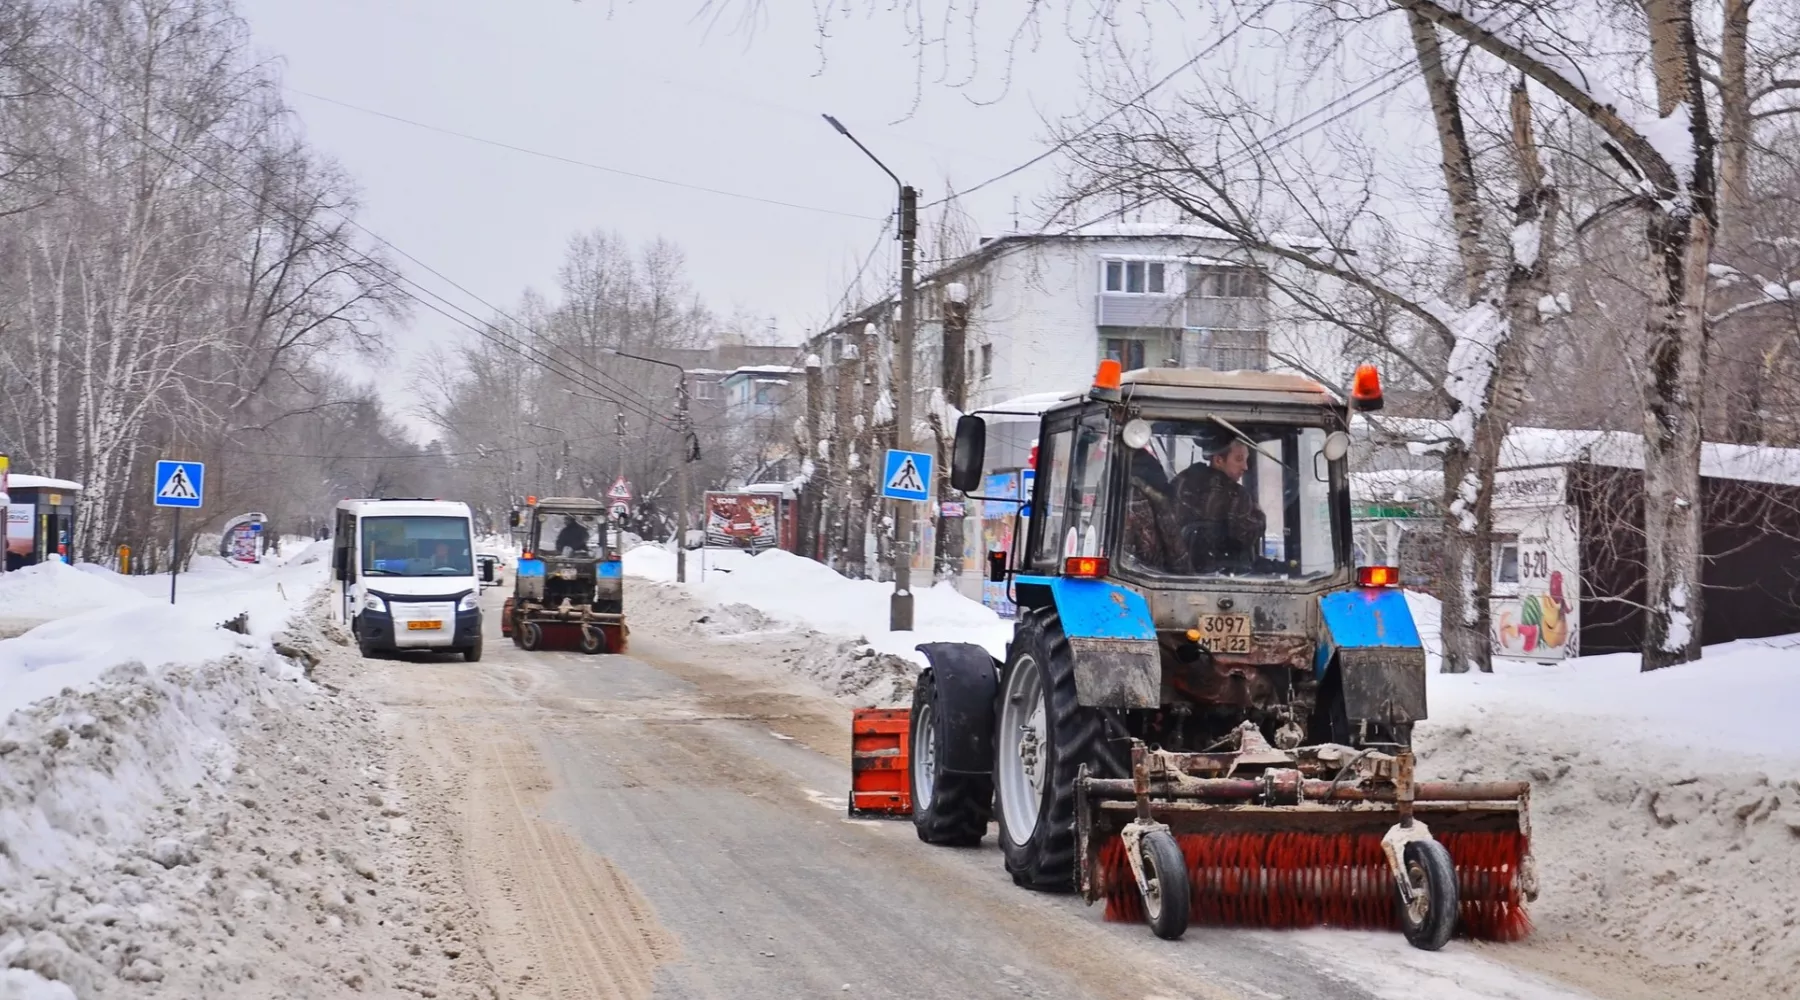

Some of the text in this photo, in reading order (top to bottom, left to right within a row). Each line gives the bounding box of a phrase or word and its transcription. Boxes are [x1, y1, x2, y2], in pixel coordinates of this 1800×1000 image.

[1523, 551, 1547, 578] 9-20
[1205, 616, 1245, 632] 3097
[1231, 639, 1246, 651] 22
